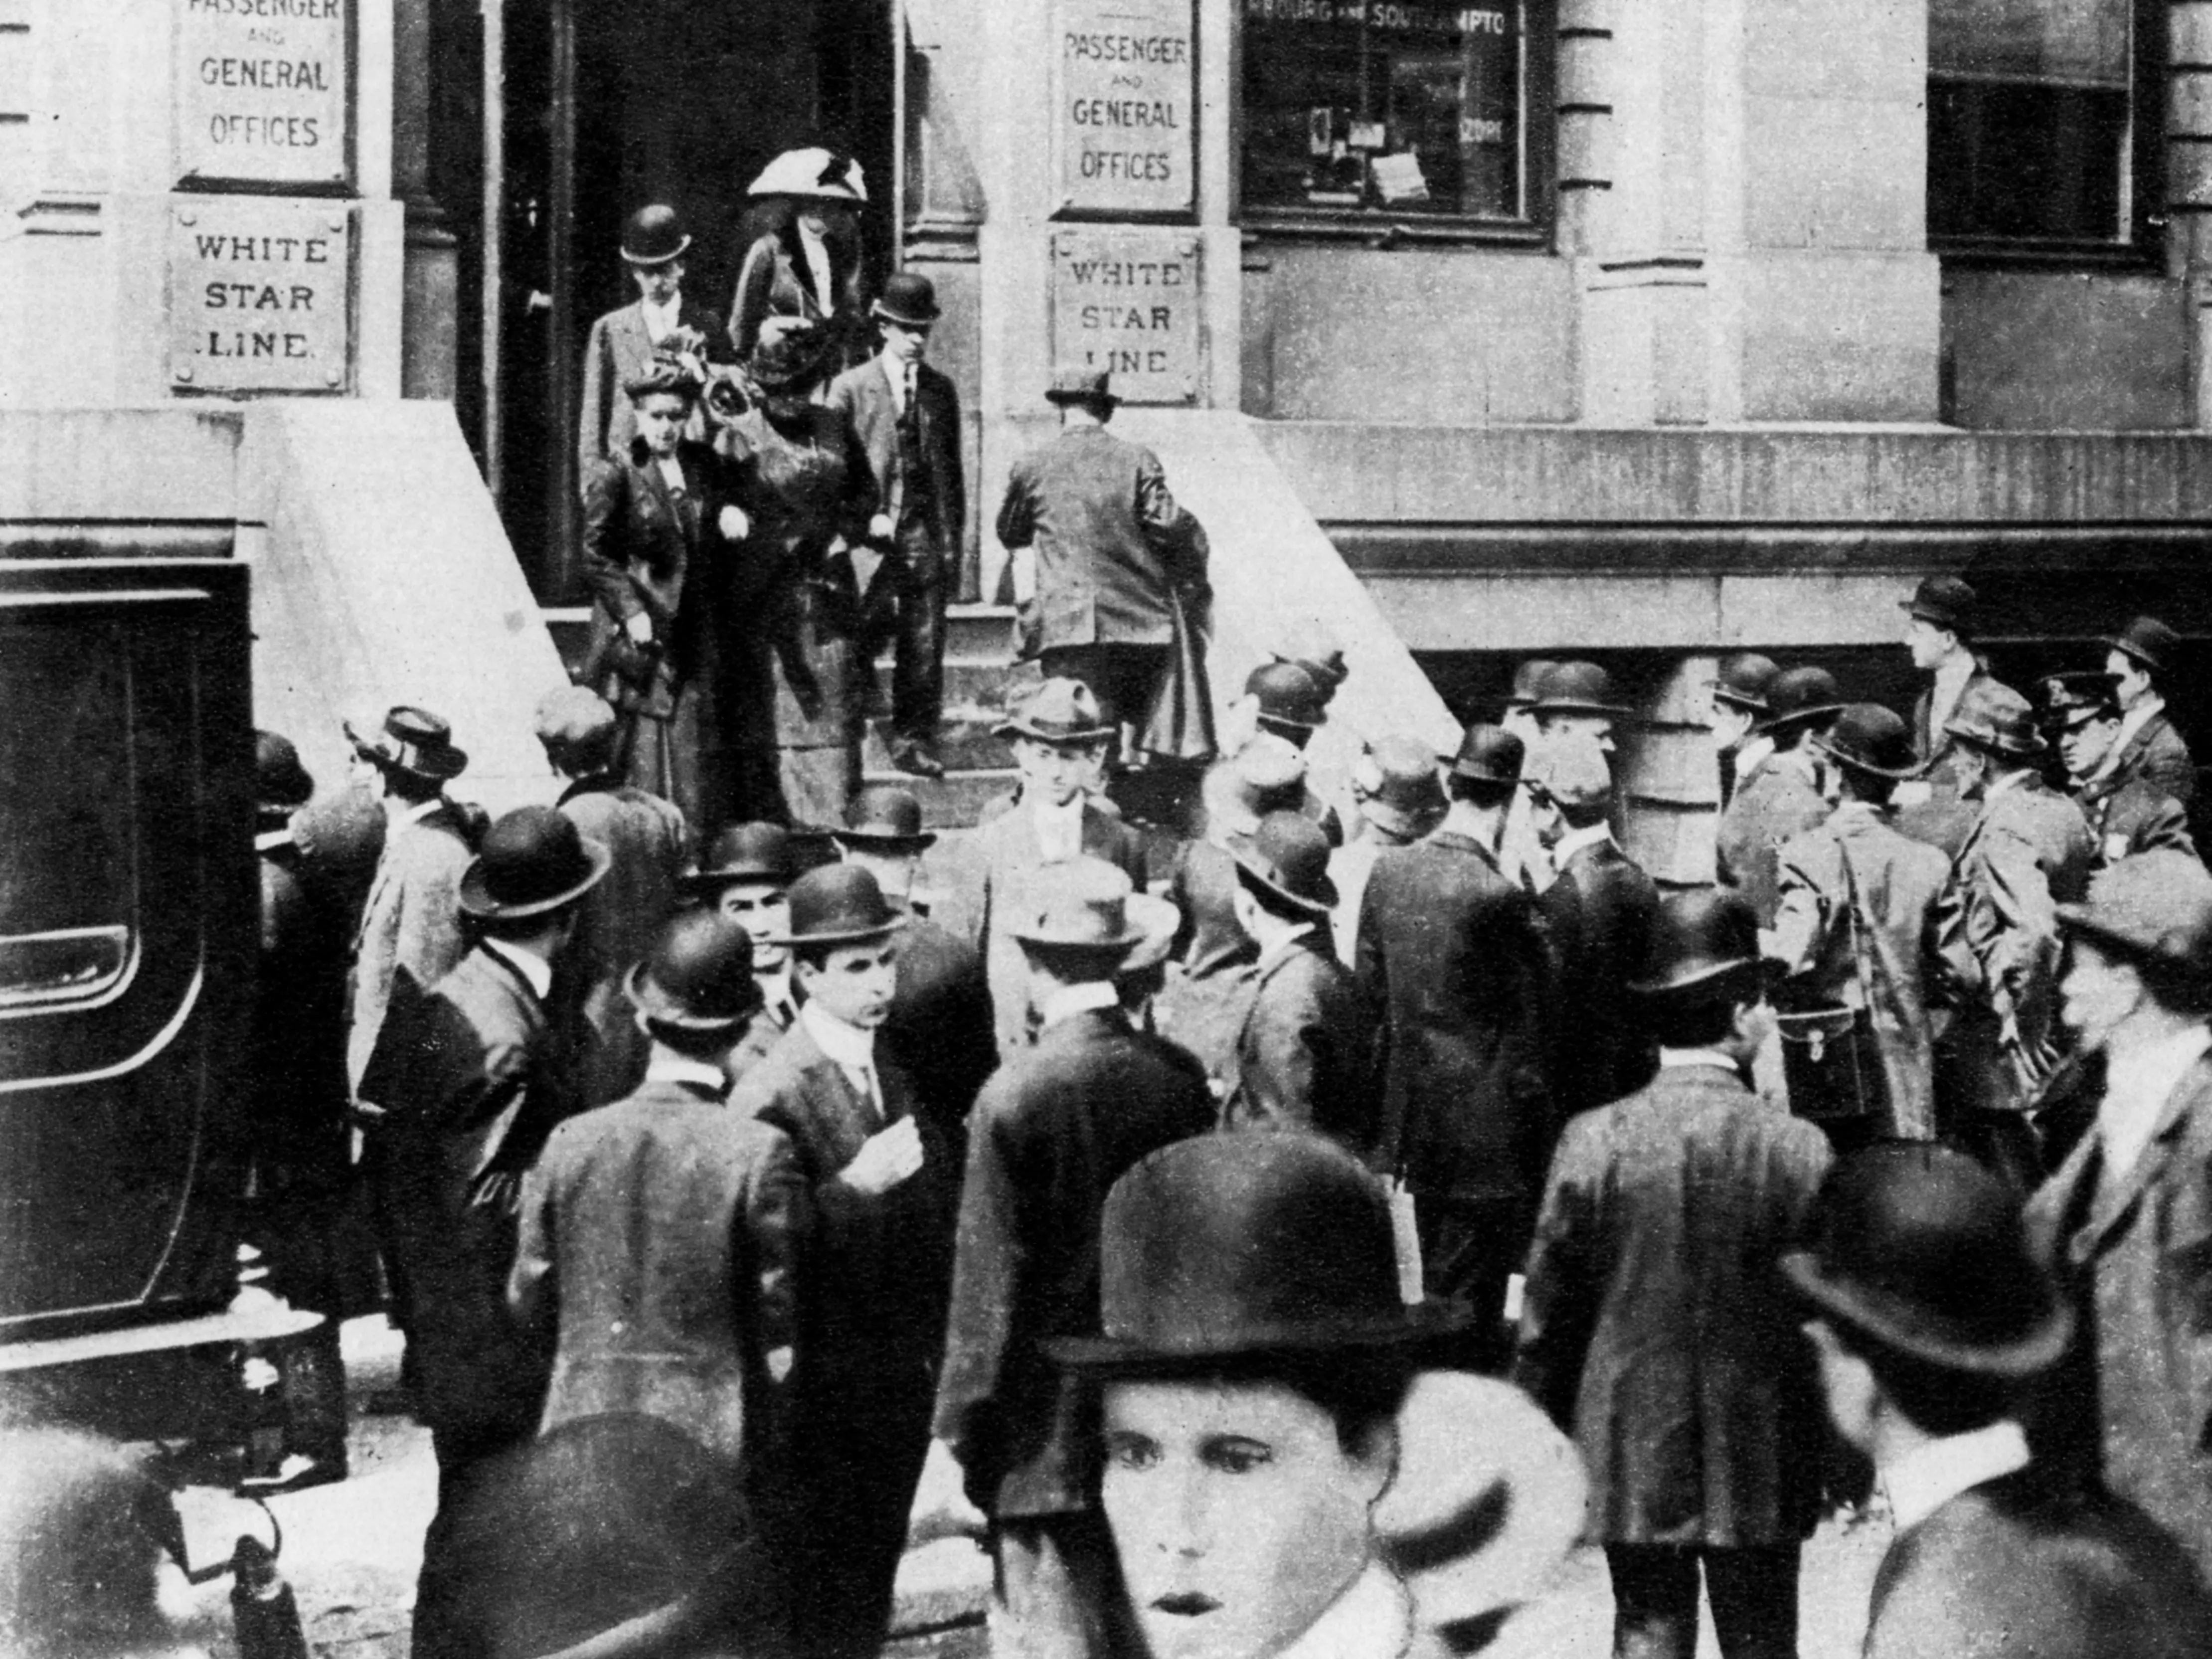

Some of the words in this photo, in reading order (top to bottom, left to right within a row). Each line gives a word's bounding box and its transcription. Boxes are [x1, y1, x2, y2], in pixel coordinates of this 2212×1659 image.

[1065, 32, 1186, 64] PASSENGER
[201, 57, 329, 91] GENERAL
[1111, 75, 1143, 89] AND
[1073, 98, 1179, 128] GENERAL
[210, 114, 319, 147] OFFICES
[1080, 151, 1171, 180] OFFICES
[195, 234, 327, 263] WHITE
[1071, 263, 1182, 285] WHITE
[205, 282, 314, 310] STAR
[1081, 306, 1171, 330] STAR
[208, 331, 307, 357] LINE
